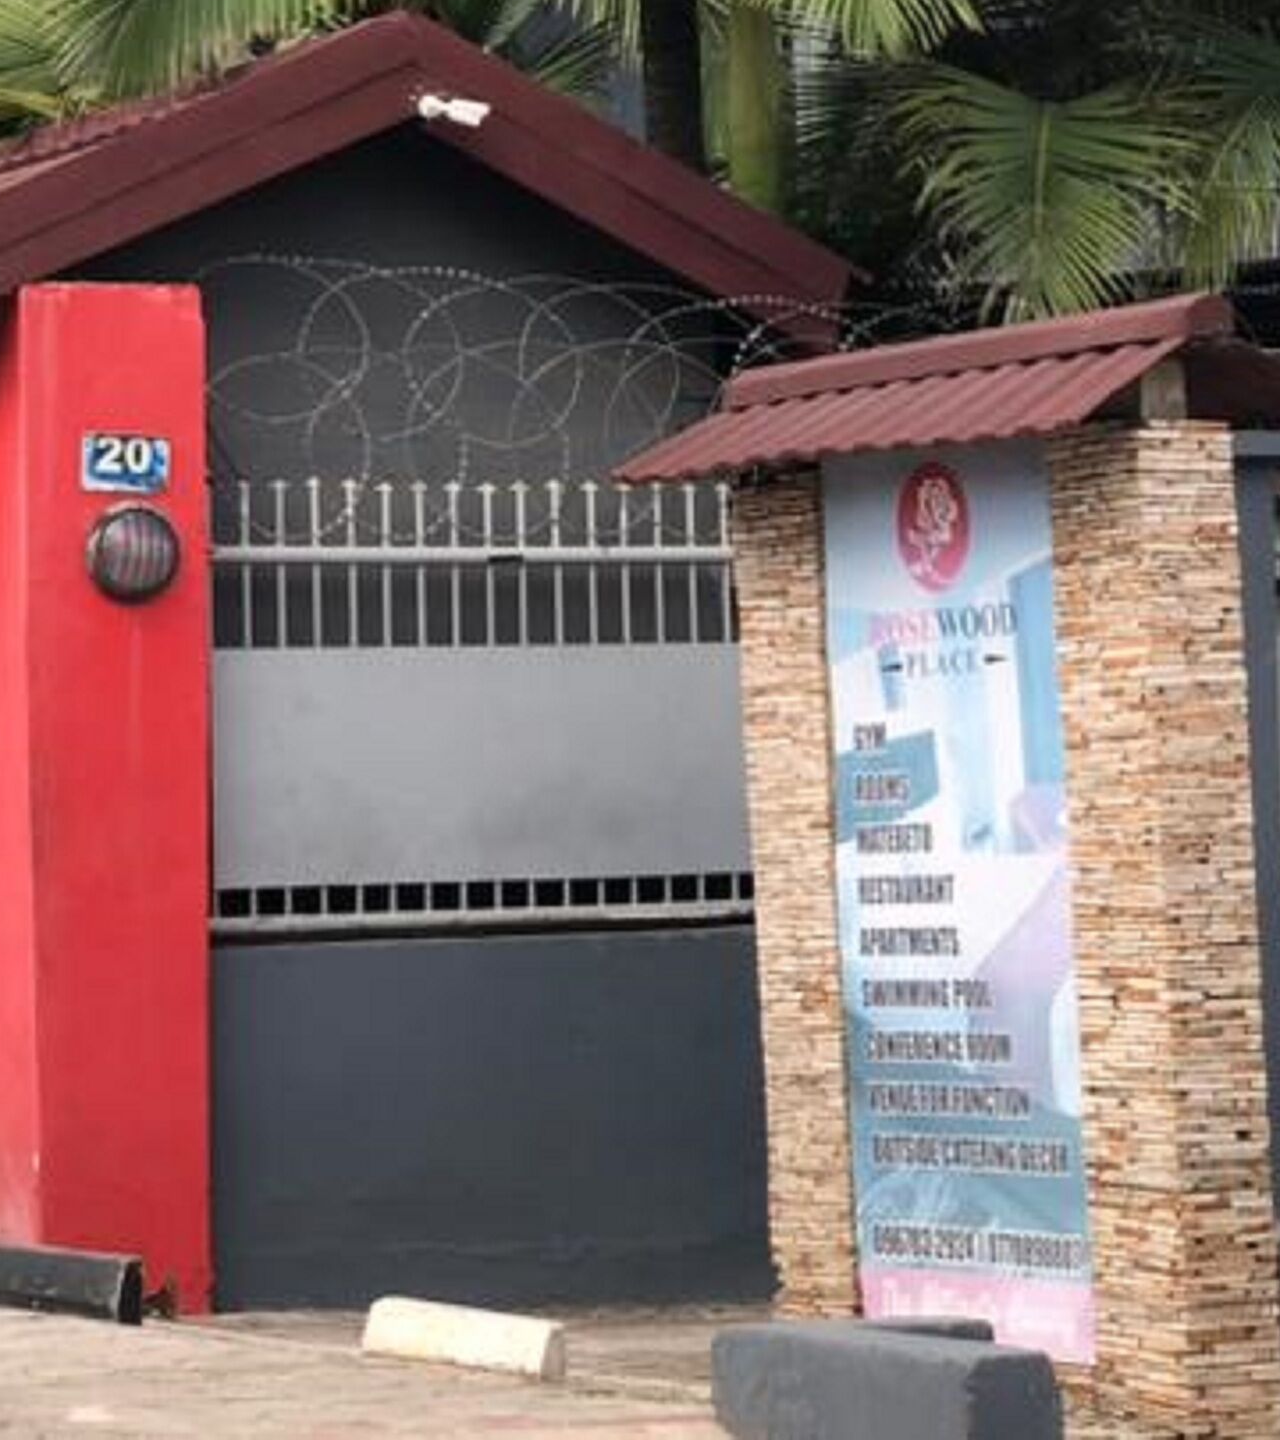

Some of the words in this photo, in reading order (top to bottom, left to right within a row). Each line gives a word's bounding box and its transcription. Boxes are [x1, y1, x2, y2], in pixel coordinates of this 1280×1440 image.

[95, 437, 151, 475] 20
[906, 648, 977, 679] PLACE
[854, 723, 887, 751] GYM
[855, 773, 909, 801] ROOMS
[858, 874, 954, 904] RESTAURANT
[860, 927, 959, 957] APARTMENTS
[862, 978, 950, 1008] SWIMMING
[953, 979, 993, 1009] POOL
[867, 1030, 963, 1061] CONFERENCE
[967, 1034, 1012, 1063] ROOM
[870, 1084, 918, 1112] VENUE
[952, 1087, 1030, 1116] FUNCTION
[873, 1133, 939, 1167] OUTSIDE
[942, 1137, 1015, 1170] CATERING
